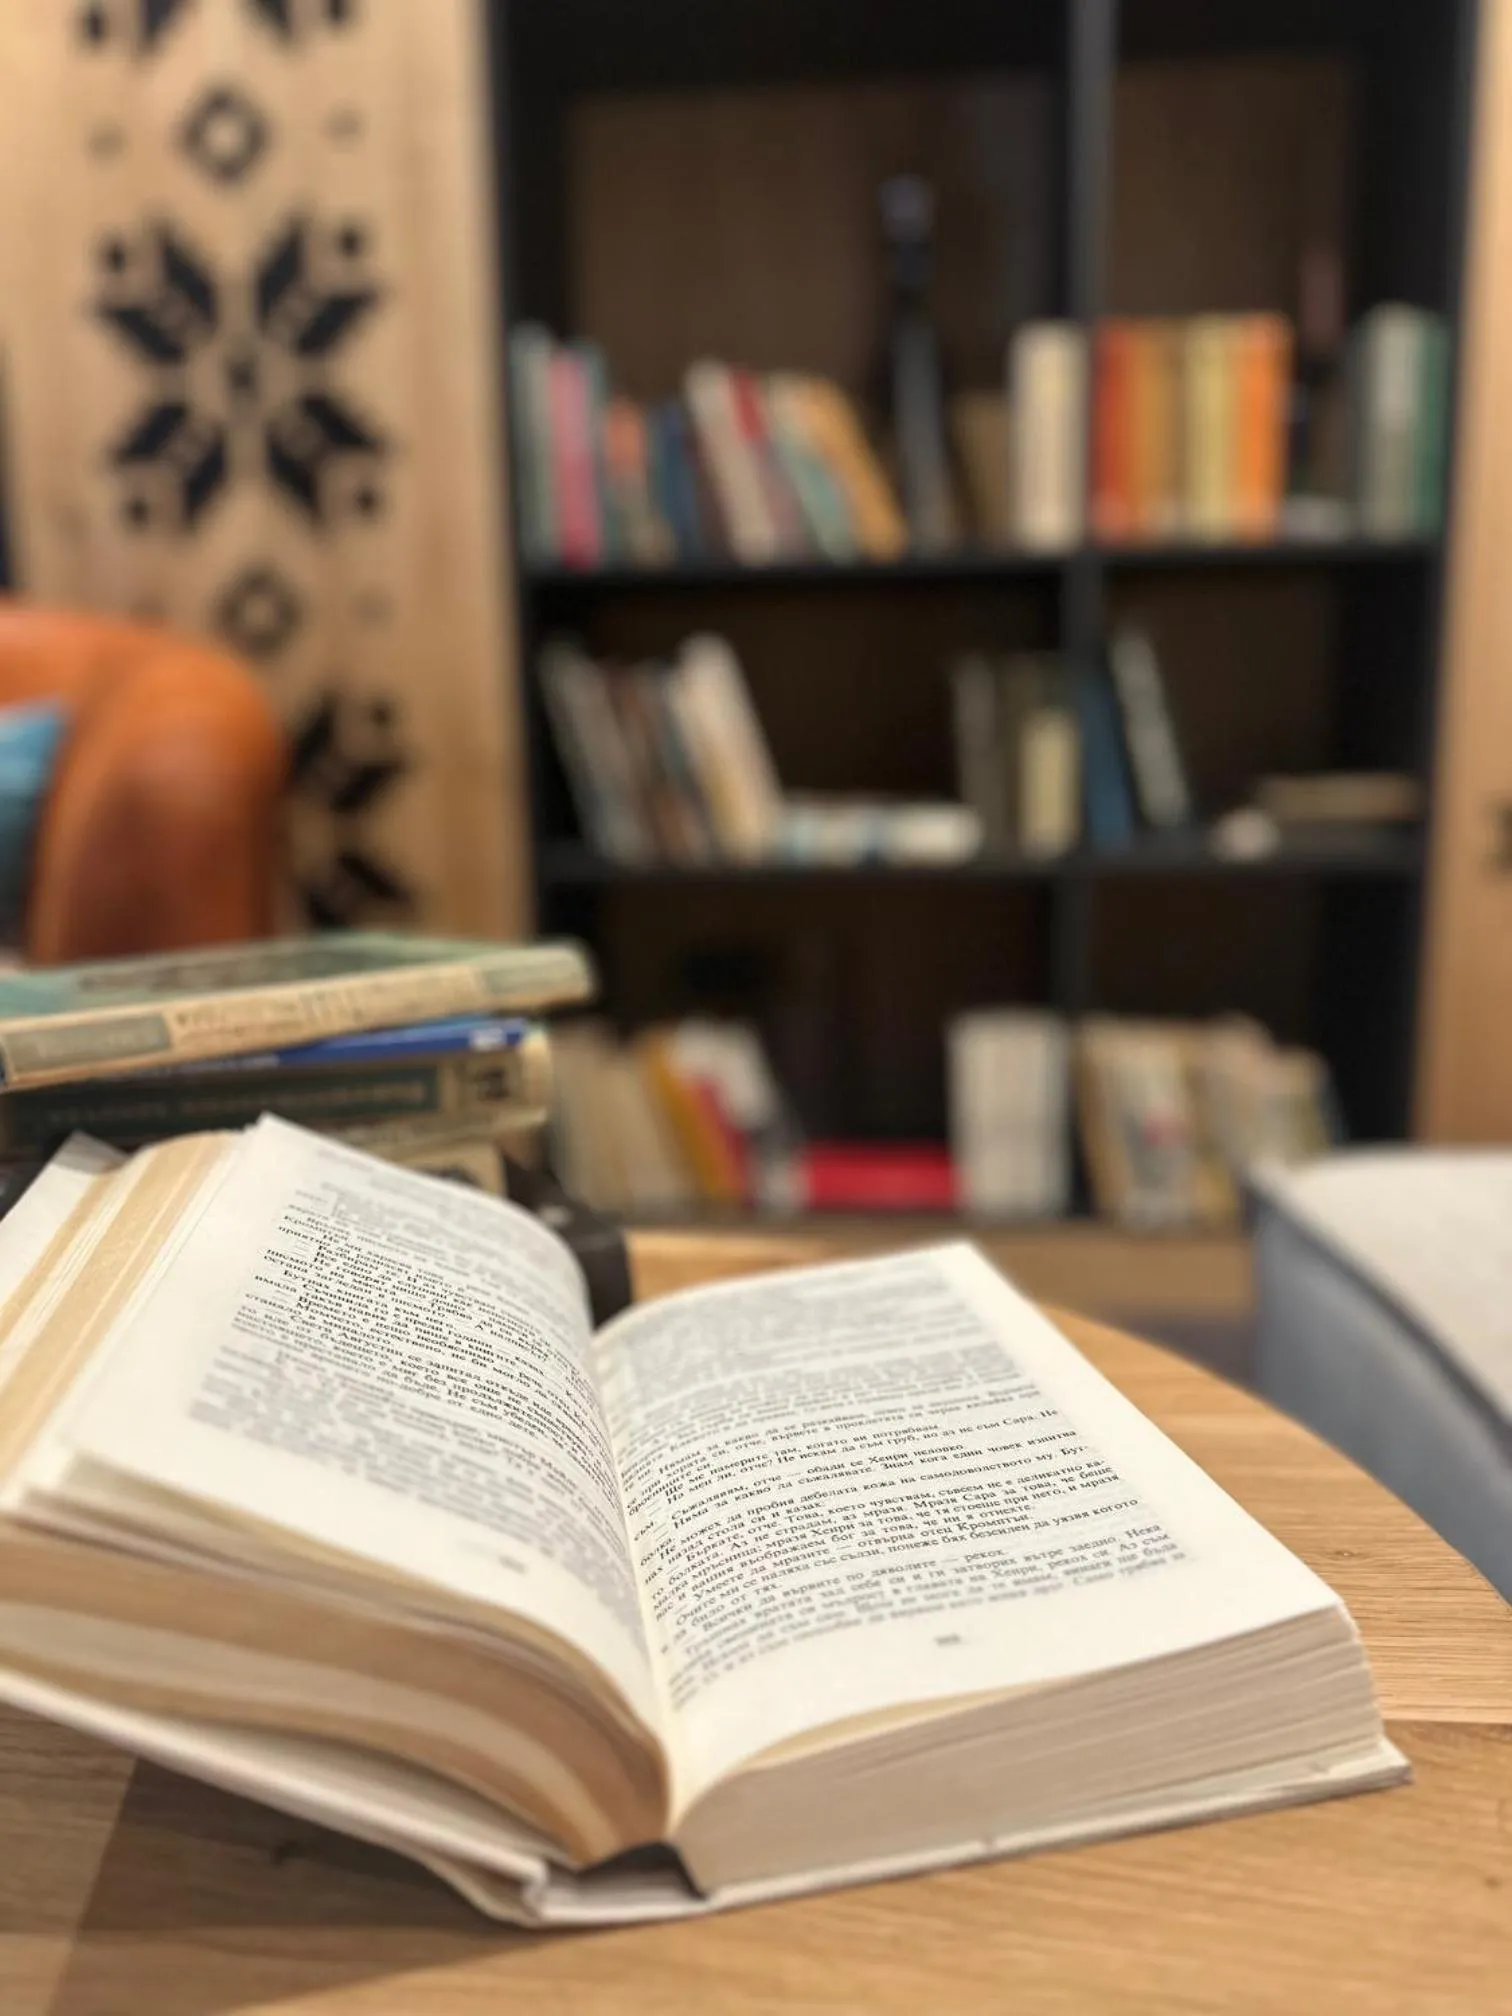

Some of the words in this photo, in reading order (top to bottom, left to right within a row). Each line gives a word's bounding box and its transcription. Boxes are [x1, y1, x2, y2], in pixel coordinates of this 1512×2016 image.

[673, 1507, 709, 1527] Няма
[733, 1485, 771, 1501] какво
[879, 1459, 914, 1470] Знам
[918, 1454, 948, 1465] кога
[952, 1448, 983, 1460] един
[987, 1441, 1022, 1454] човек
[1026, 1429, 1076, 1446] изпитва
[688, 1478, 712, 1493] мен
[798, 1447, 837, 1459] искам
[859, 1439, 883, 1450] съм
[976, 1420, 1000, 1431] съм
[709, 1452, 769, 1475] намерите
[805, 1437, 848, 1451] когато
[752, 1473, 782, 1487] отче
[806, 1462, 845, 1475] обади
[867, 1452, 908, 1464] Хенри
[680, 1520, 722, 1545] можех
[746, 1497, 795, 1515] пробия
[799, 1485, 857, 1504] дебелата
[862, 1479, 896, 1491] кожа
[685, 1534, 745, 1561] Бъркате,
[786, 1510, 824, 1523] Това,
[827, 1501, 865, 1515] което
[868, 1491, 935, 1508] чувствам,
[937, 1483, 984, 1497] съвсем
[1016, 1463, 1083, 1485] деликатно
[764, 1532, 807, 1549] мразя
[810, 1523, 855, 1537] Хенри
[876, 1514, 914, 1525] това,
[952, 1499, 1001, 1513] стоеше
[1003, 1494, 1028, 1505] при
[1031, 1488, 1067, 1500] него,
[1079, 1473, 1119, 1489] мразя
[774, 1518, 837, 1536] страдам,
[912, 1496, 958, 1510] Мразя
[961, 1490, 997, 1502] Сара
[1022, 1480, 1058, 1492] това,
[1078, 1466, 1113, 1480] беше
[667, 1538, 703, 1564] назад
[706, 1521, 745, 1541] стола
[690, 1565, 734, 1592] вашия
[739, 1538, 825, 1568] въображаем
[830, 1532, 856, 1543] бог
[882, 1522, 919, 1533] това,
[693, 1572, 744, 1600] Умеете
[772, 1547, 830, 1567] мразите
[856, 1531, 915, 1548] отвърна
[919, 1526, 953, 1537] отец
[760, 1562, 810, 1582] наляха
[887, 1537, 939, 1553] понеже
[941, 1533, 967, 1544] бях
[968, 1523, 1030, 1539] безсилен
[1092, 1498, 1138, 1515] когото
